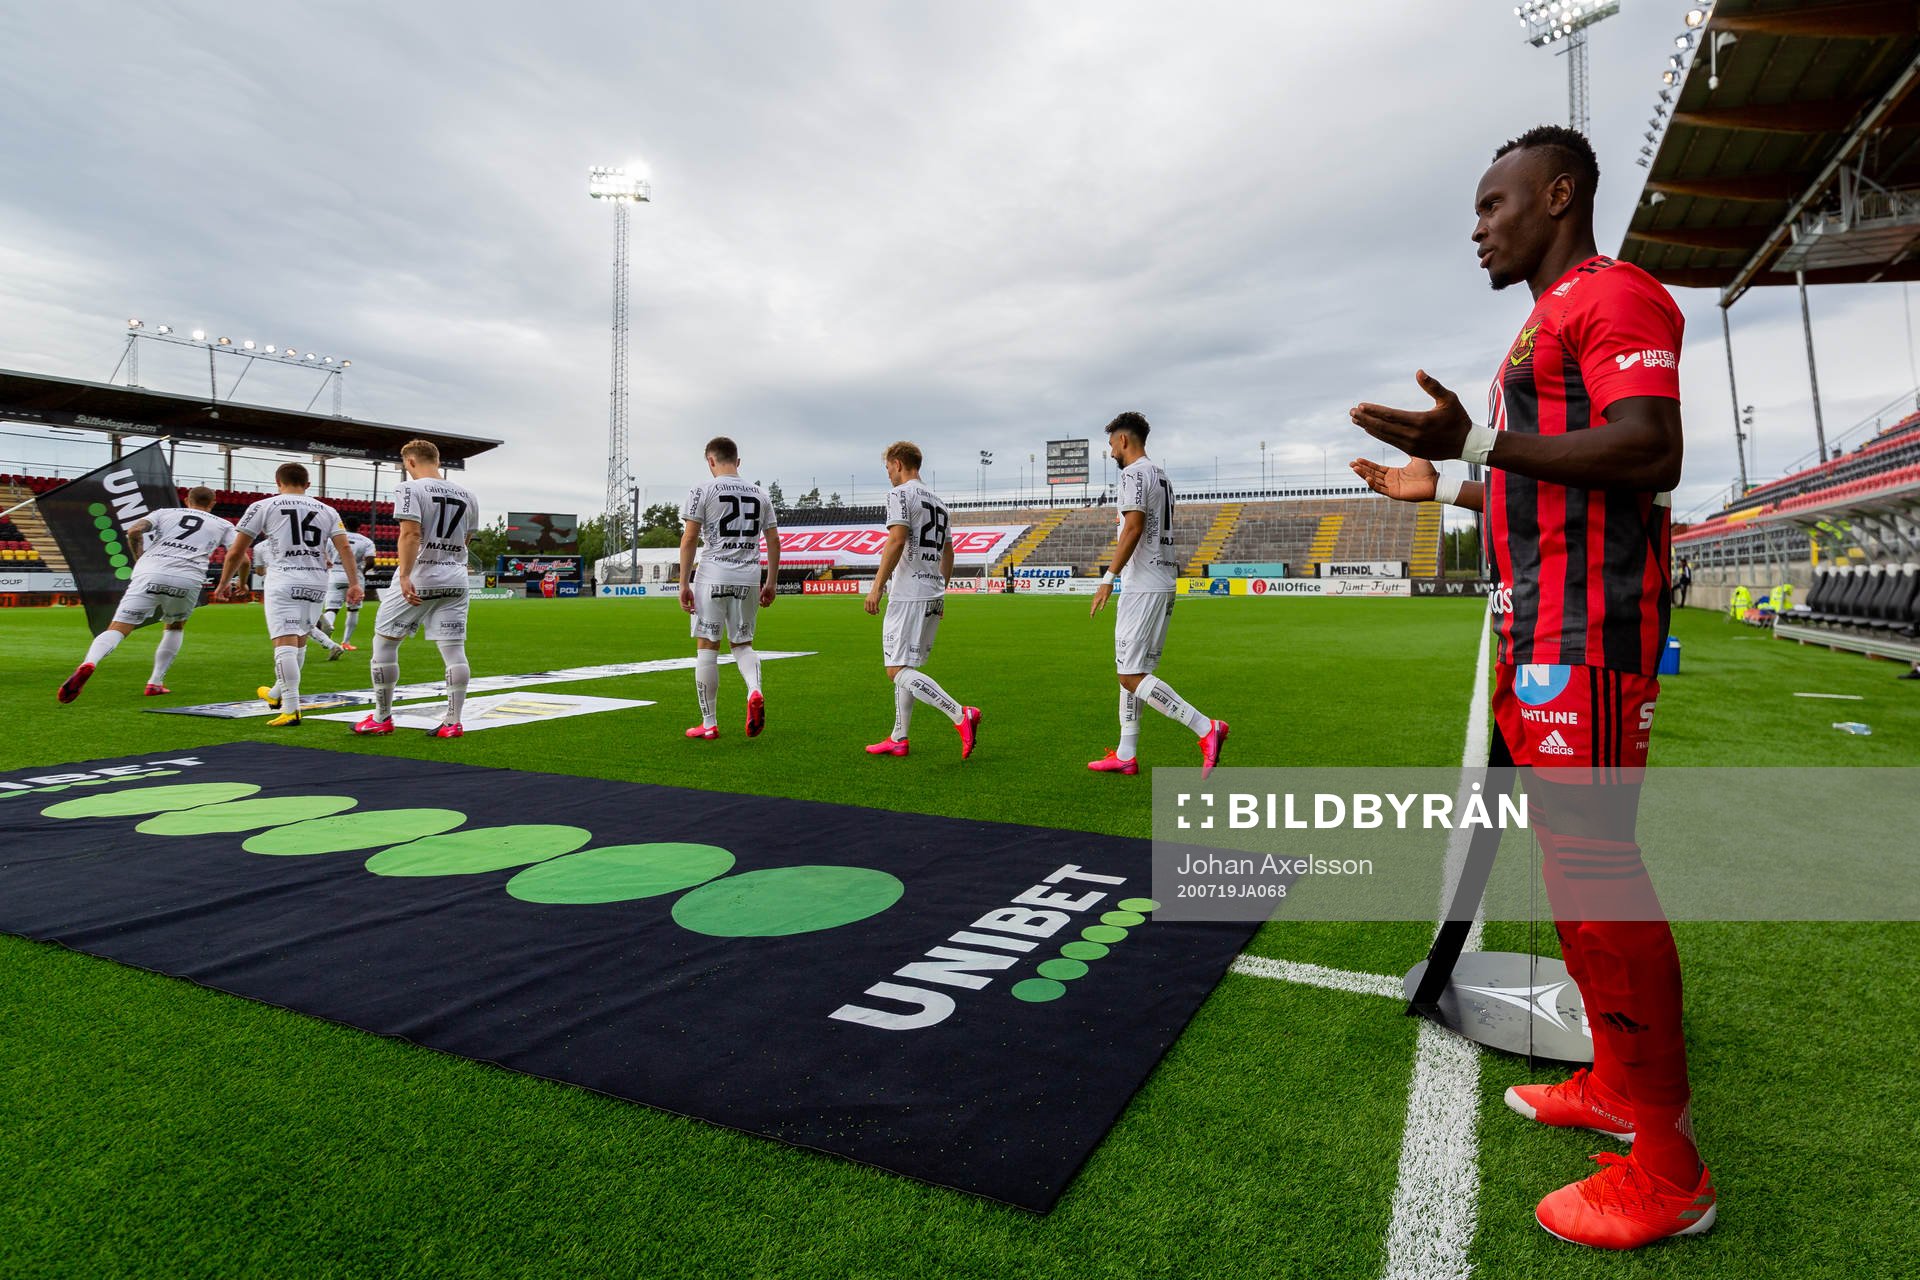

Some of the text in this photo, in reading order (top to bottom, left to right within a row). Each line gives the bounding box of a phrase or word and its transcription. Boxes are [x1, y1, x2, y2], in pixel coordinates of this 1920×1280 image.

[1642, 350, 1675, 361] INTER
[1643, 359, 1676, 370] SPORT
[74, 414, 158, 433] Bilbolaget.com
[715, 483, 761, 494] Glimstedt
[1135, 471, 1143, 505] stadium
[402, 487, 411, 514] stadium
[900, 490, 908, 520] stadium
[1158, 478, 1175, 531] 1
[102, 468, 156, 553] UNI
[432, 496, 467, 539] 17
[718, 494, 761, 538] 23
[175, 515, 204, 541] 9
[280, 508, 322, 547] 16
[919, 500, 949, 552] 28
[161, 540, 199, 553] MAXXIS
[1022, 568, 1071, 579] attacus
[1243, 567, 1257, 575] SCA
[1330, 565, 1373, 576] MEINDL
[53, 577, 76, 588] ze
[615, 586, 647, 596] INAB
[805, 583, 858, 593] BAUHAUS
[1038, 578, 1066, 588] SEP
[1268, 582, 1321, 594] AllOffice
[1521, 708, 1578, 725] HTLINE
[1538, 743, 1574, 756] adidas
[827, 863, 1128, 1031] UNIBET
[1591, 1105, 1636, 1130] NEMESIS
